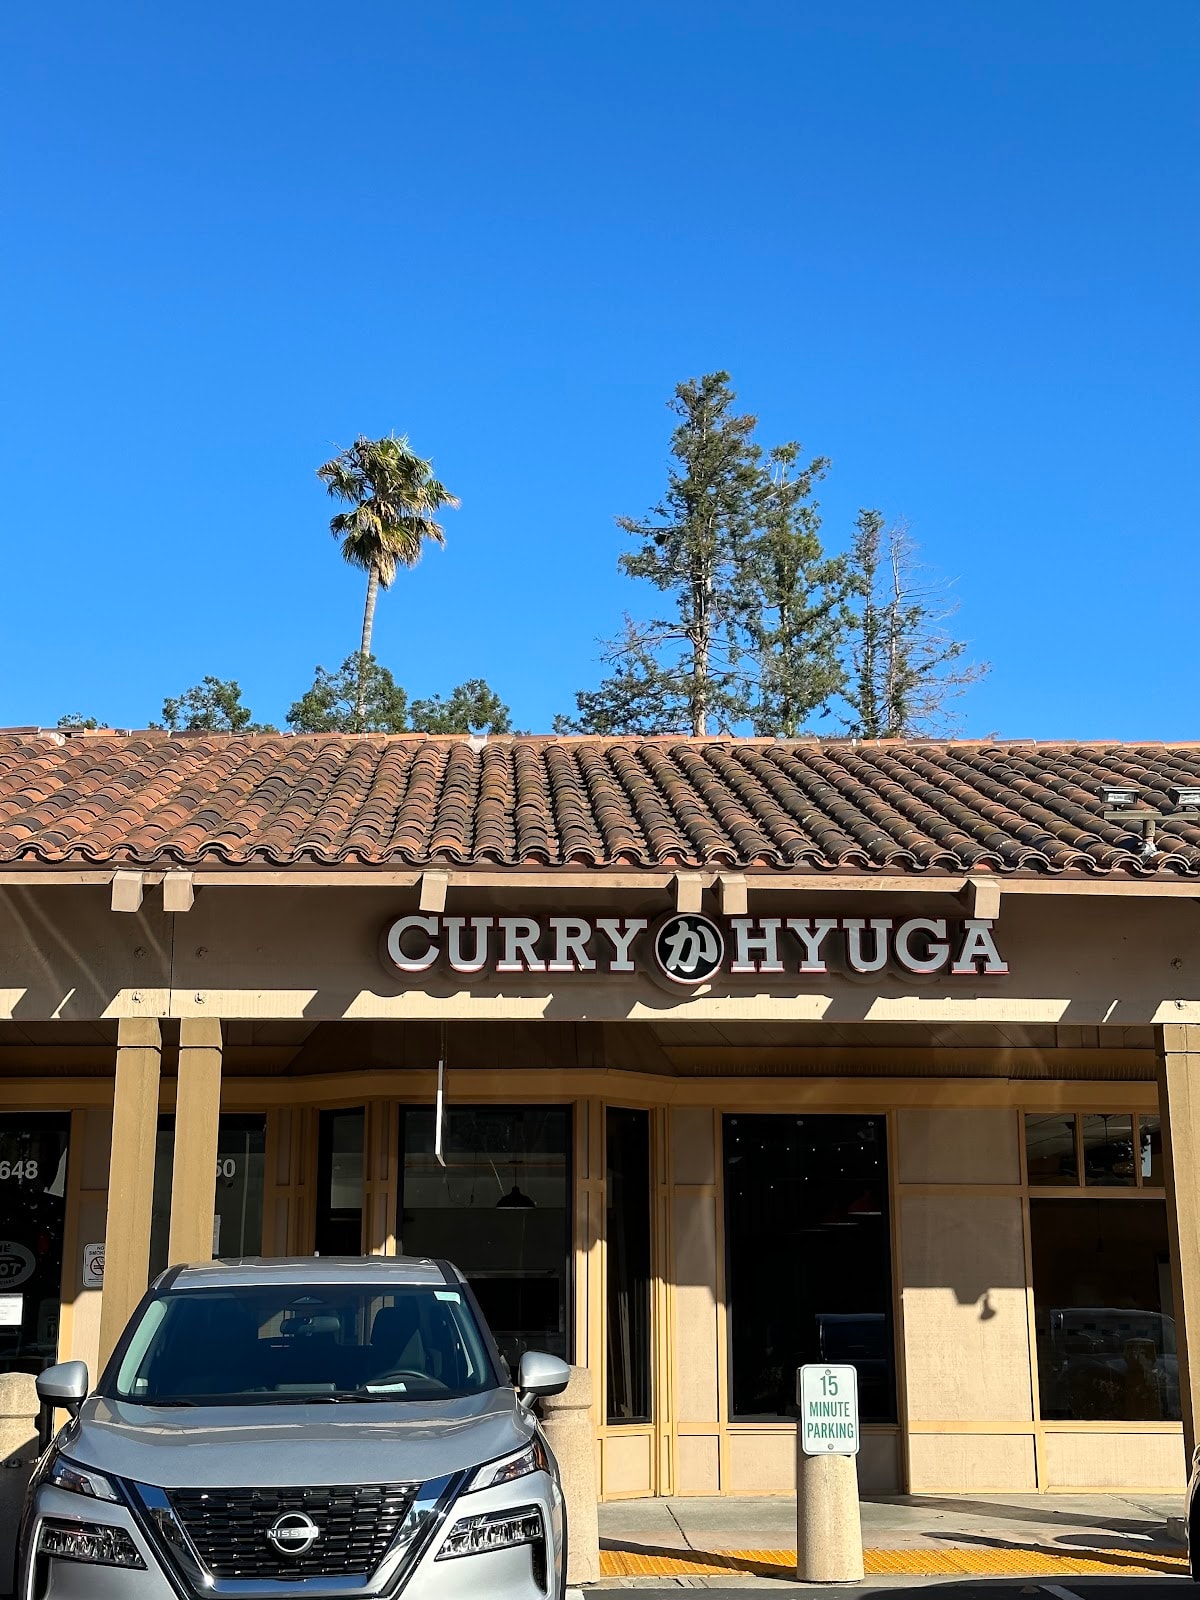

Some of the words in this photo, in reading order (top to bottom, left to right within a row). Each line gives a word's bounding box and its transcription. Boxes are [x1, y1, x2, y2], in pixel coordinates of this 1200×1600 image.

[386, 914, 649, 973] CURRY
[663, 919, 718, 973] か
[730, 916, 1011, 975] HYUGA
[0, 1160, 38, 1180] 648
[819, 1375, 839, 1396] 15
[809, 1401, 851, 1418] MINUTE
[807, 1422, 854, 1439] PARKING
